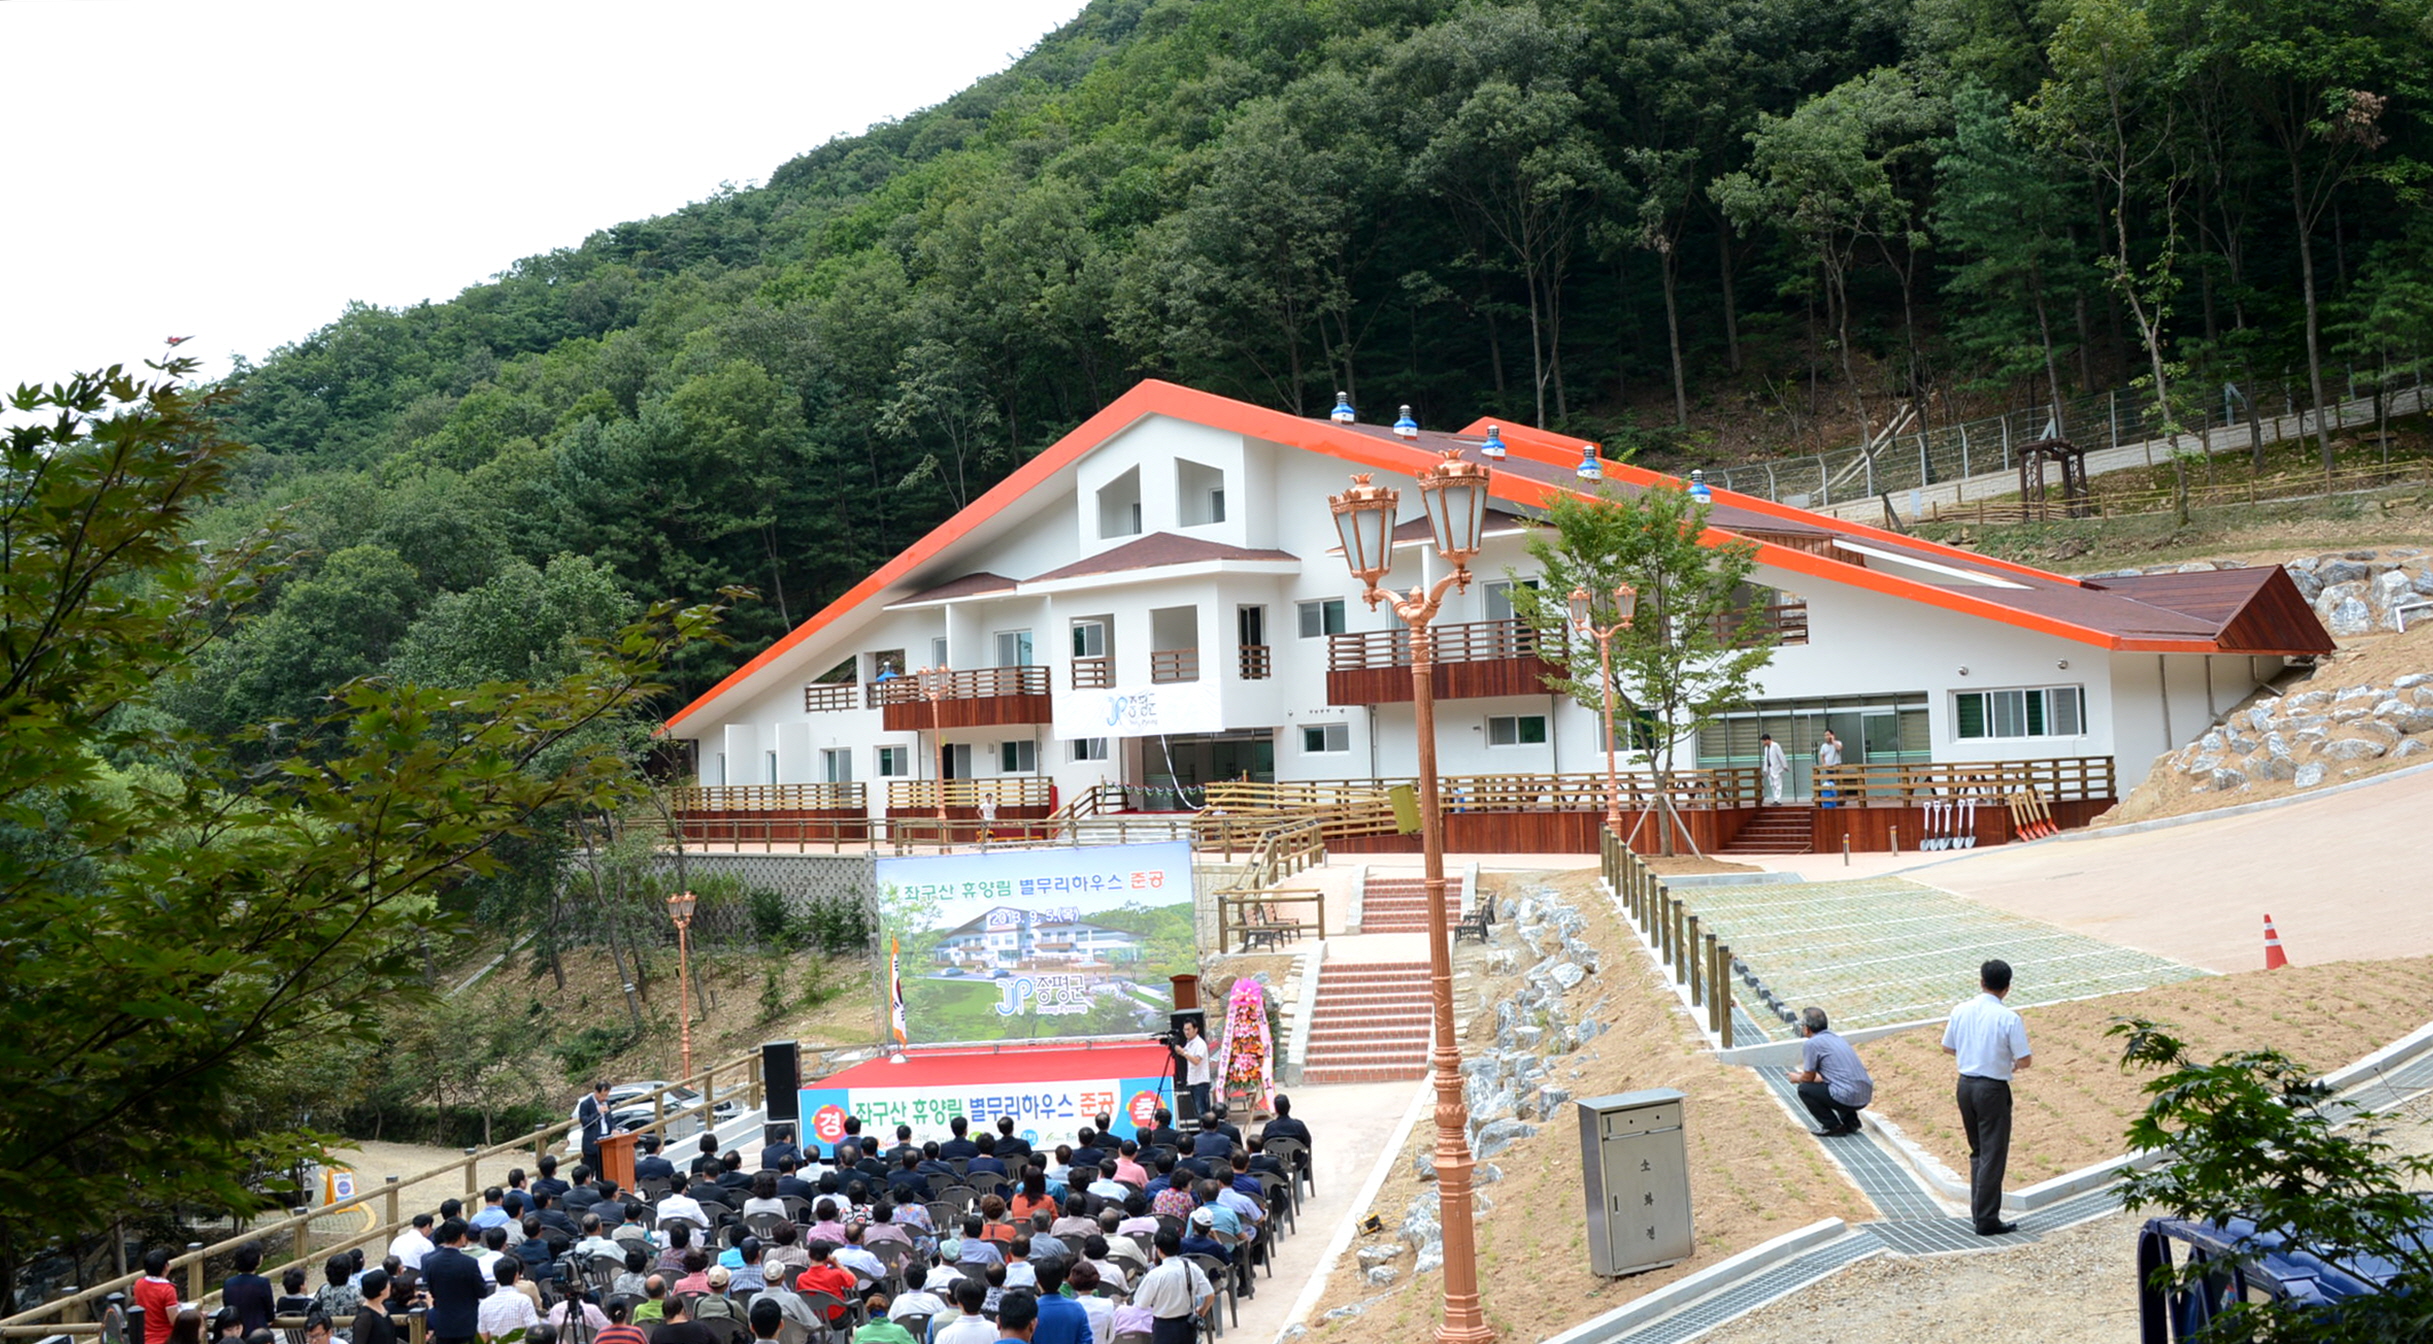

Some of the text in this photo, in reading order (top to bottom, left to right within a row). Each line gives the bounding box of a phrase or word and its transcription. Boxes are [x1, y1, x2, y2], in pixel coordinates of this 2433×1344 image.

[904, 871, 1165, 902] 좌구산 휴양림 별무리하우스 준공
[991, 911, 1025, 925] 2013.
[1037, 975, 1084, 1003] 증평군
[855, 1091, 1114, 1126] 좌구산 휴양림 별무리하우스 준공
[1134, 1098, 1156, 1120] 축
[818, 1113, 842, 1135] 경
